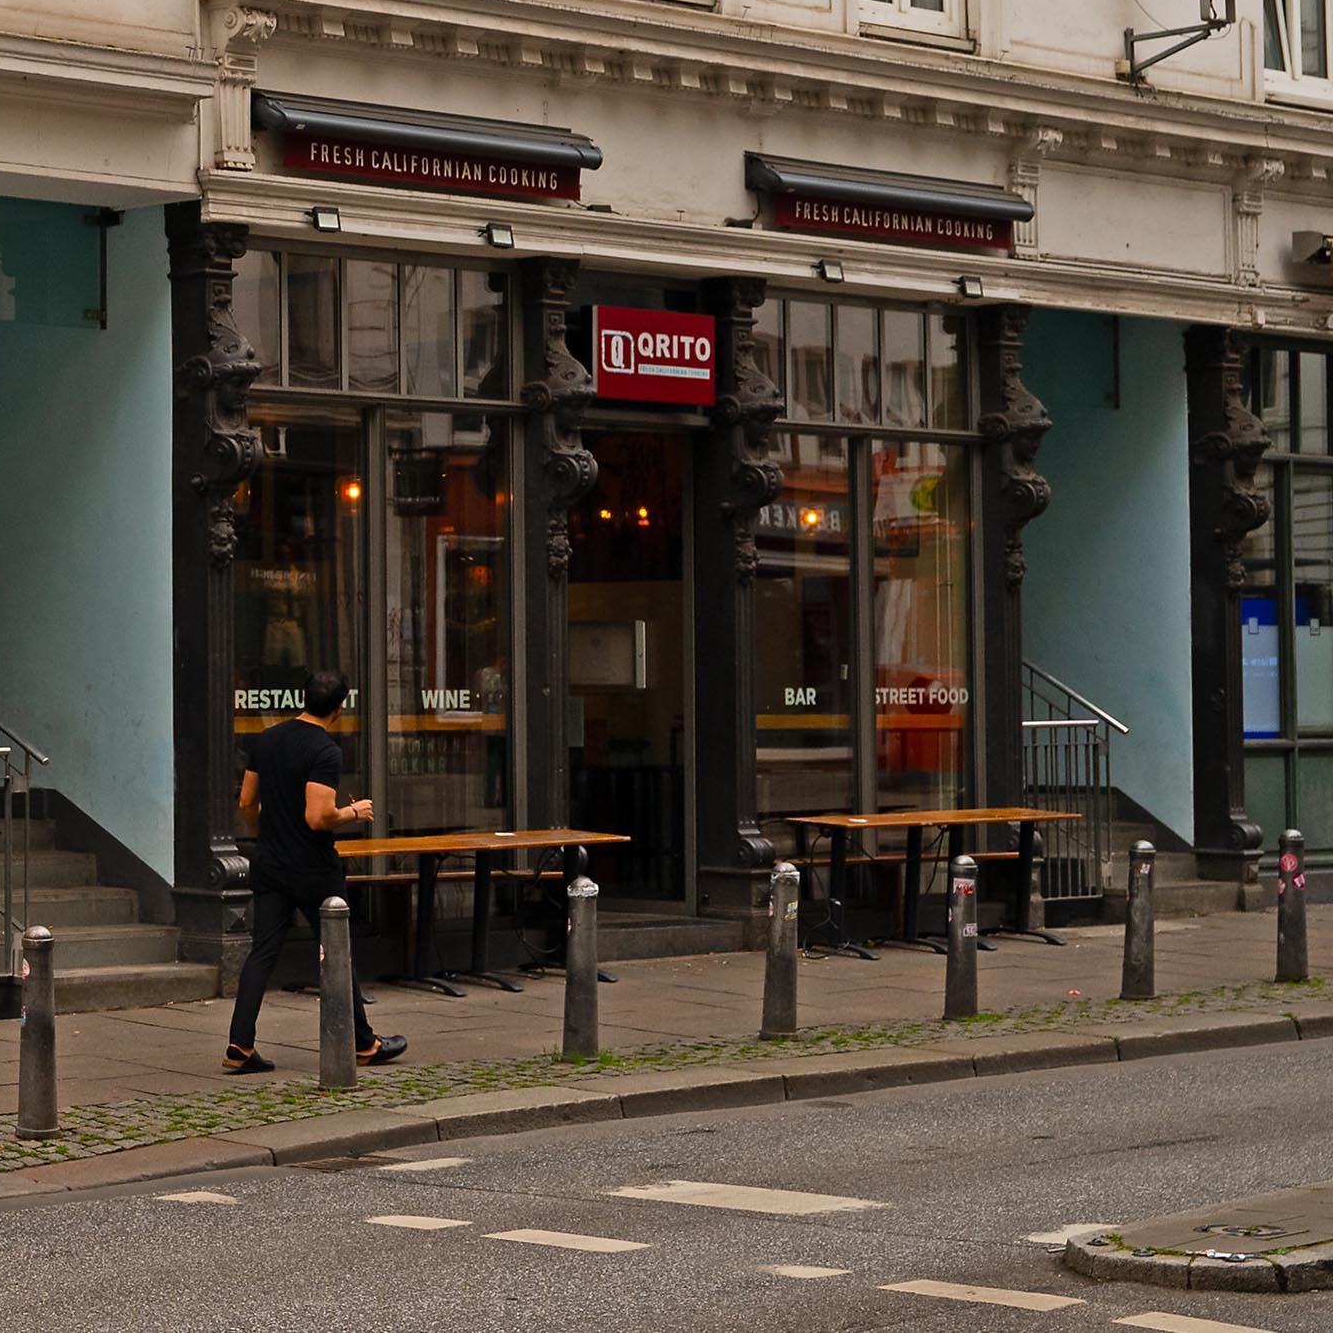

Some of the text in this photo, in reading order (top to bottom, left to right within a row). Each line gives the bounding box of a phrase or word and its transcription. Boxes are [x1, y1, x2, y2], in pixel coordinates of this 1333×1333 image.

[310, 142, 558, 191] FRESH CALIFORNIAN COOKING
[795, 201, 993, 241] FRESH CALIFORNIAN COOKING
[637, 331, 711, 362] QRITO
[234, 688, 359, 710] RESTAUT
[421, 689, 471, 709] WINE
[784, 686, 817, 706] BAR
[875, 686, 969, 705] STREET FOOD
